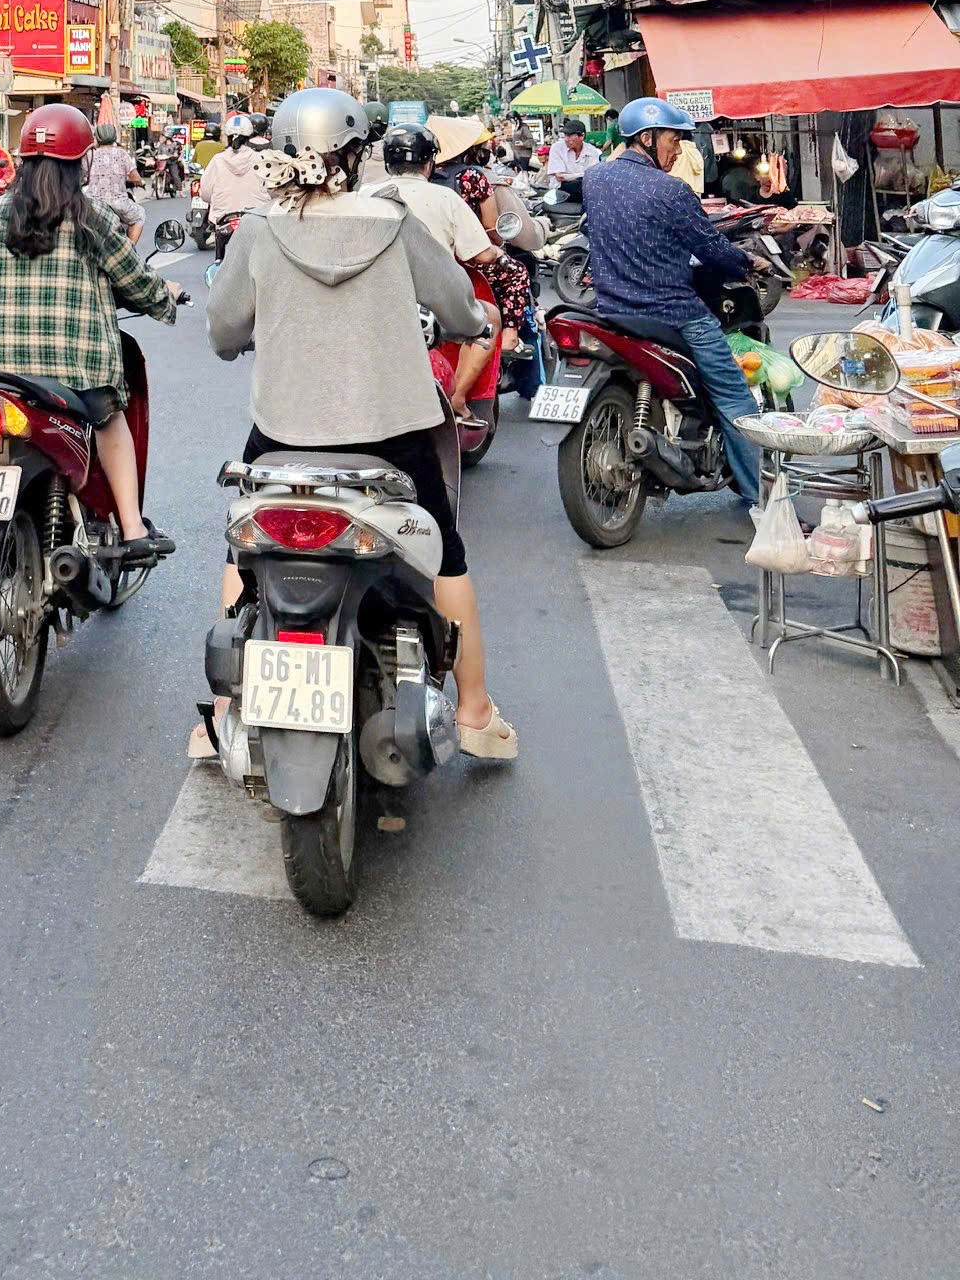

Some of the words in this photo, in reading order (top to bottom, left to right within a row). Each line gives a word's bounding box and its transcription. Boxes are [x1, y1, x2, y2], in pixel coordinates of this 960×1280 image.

[13, 3, 58, 32] Cake
[542, 387, 580, 403] 59-C4
[536, 403, 580, 419] 168.46
[260, 648, 332, 687] 66-M1
[248, 684, 345, 726] 474.89
